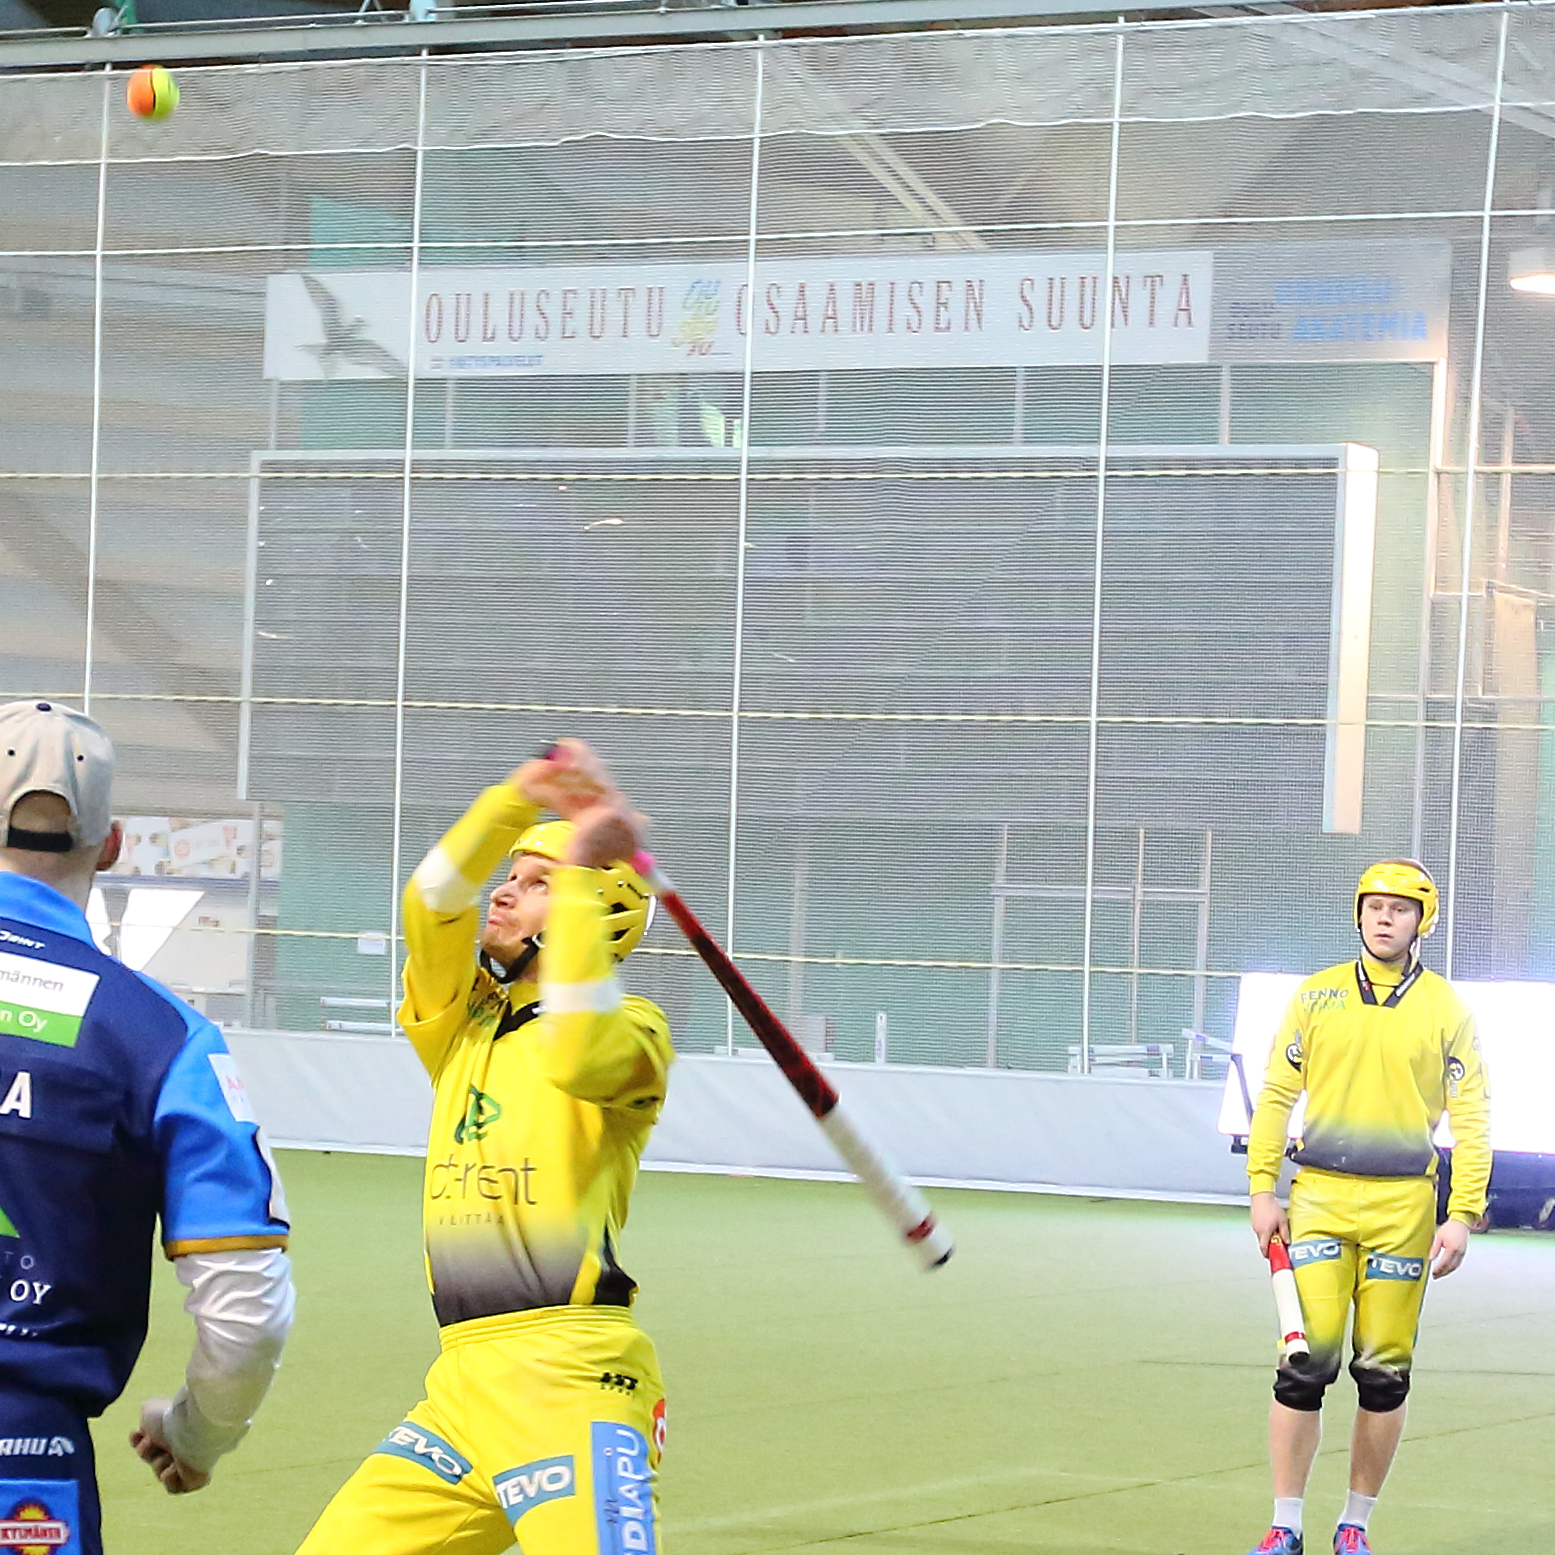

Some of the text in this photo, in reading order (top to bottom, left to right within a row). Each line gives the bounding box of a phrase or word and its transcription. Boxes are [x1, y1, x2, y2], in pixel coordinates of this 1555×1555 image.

[425, 285, 666, 343] OULUSEUTU
[735, 277, 986, 337] OSAAMISEN
[1018, 274, 1195, 331] SUUNTA
[18, 1011, 48, 1033] Oy
[1369, 1255, 1423, 1277] TEVO
[10, 1279, 51, 1305] OY
[496, 1465, 573, 1510] TEVO
